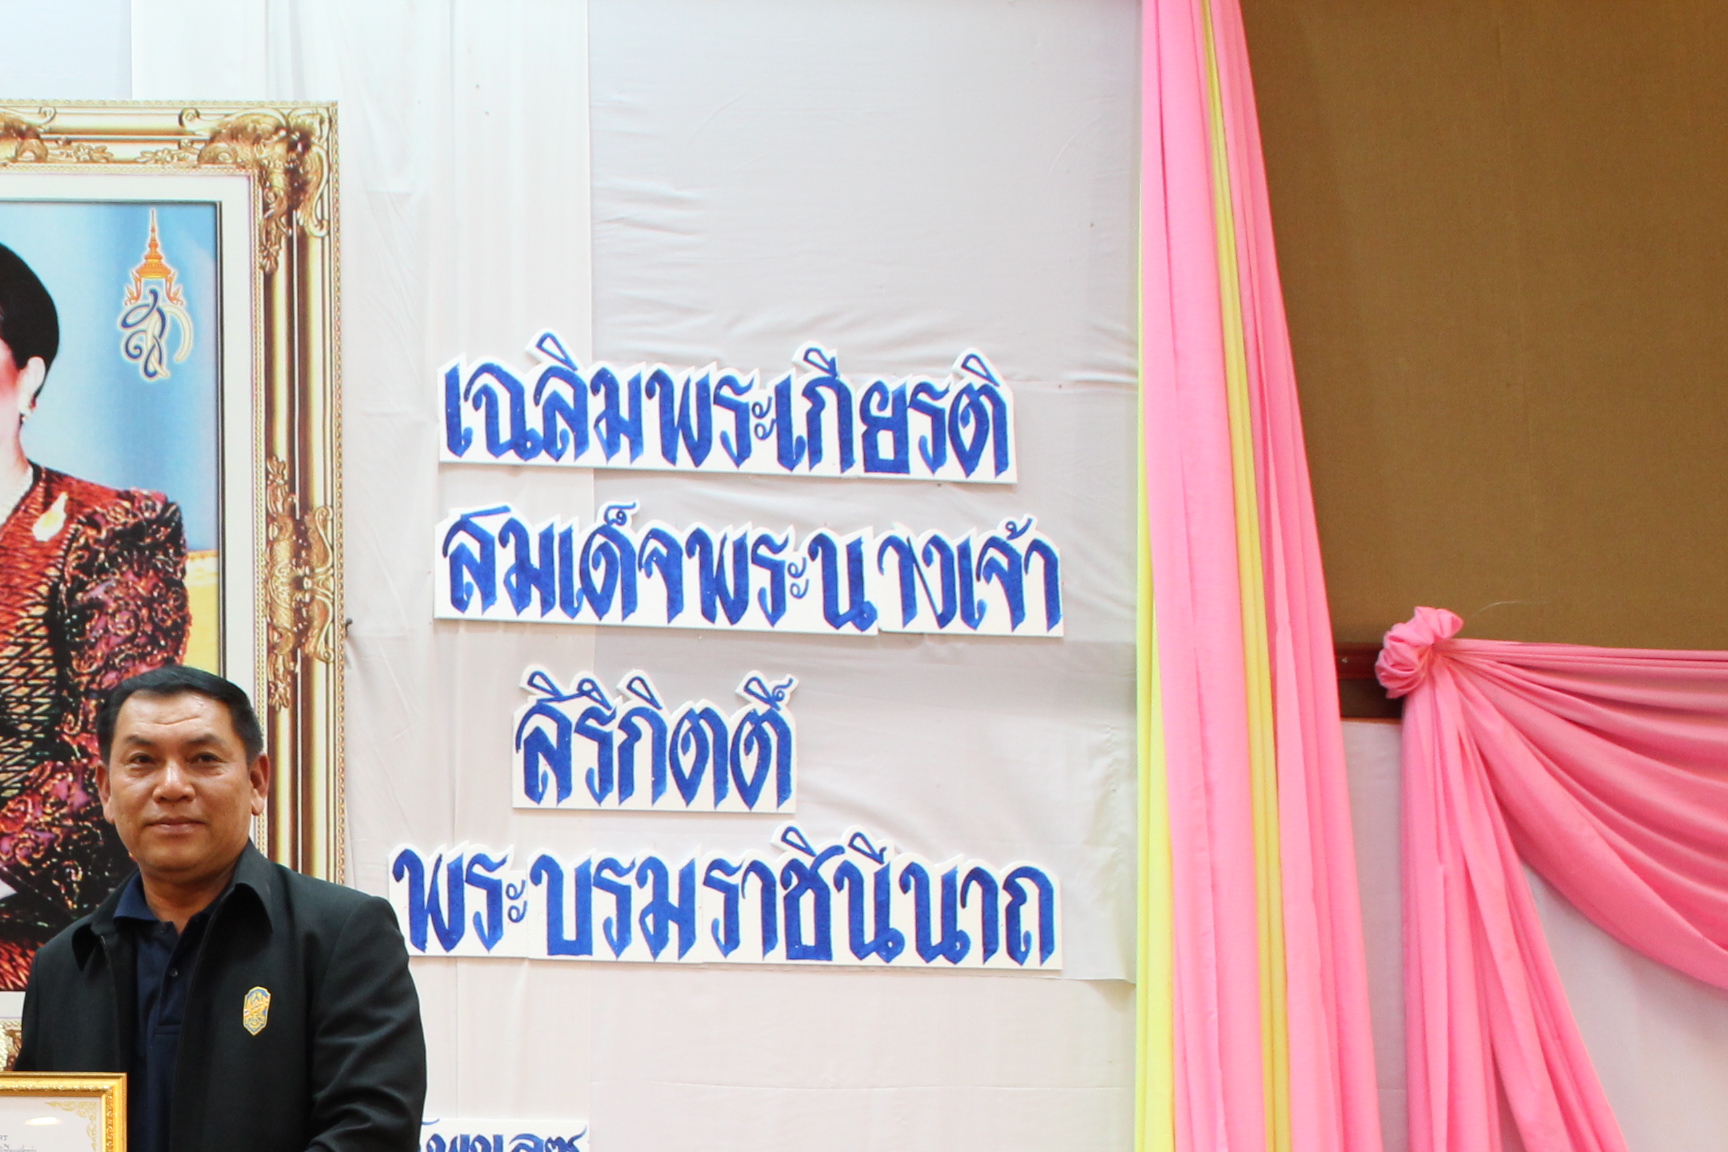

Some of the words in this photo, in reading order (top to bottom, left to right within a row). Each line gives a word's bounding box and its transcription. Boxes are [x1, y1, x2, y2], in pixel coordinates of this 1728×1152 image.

[445, 332, 1010, 476] เฉลิมพระเกียรติ
[444, 502, 1063, 631] สมเด็จพระนางเจ้า
[517, 670, 794, 808] สิริกิตติ์
[394, 826, 1056, 965] พระบรมราชินีนาถ
